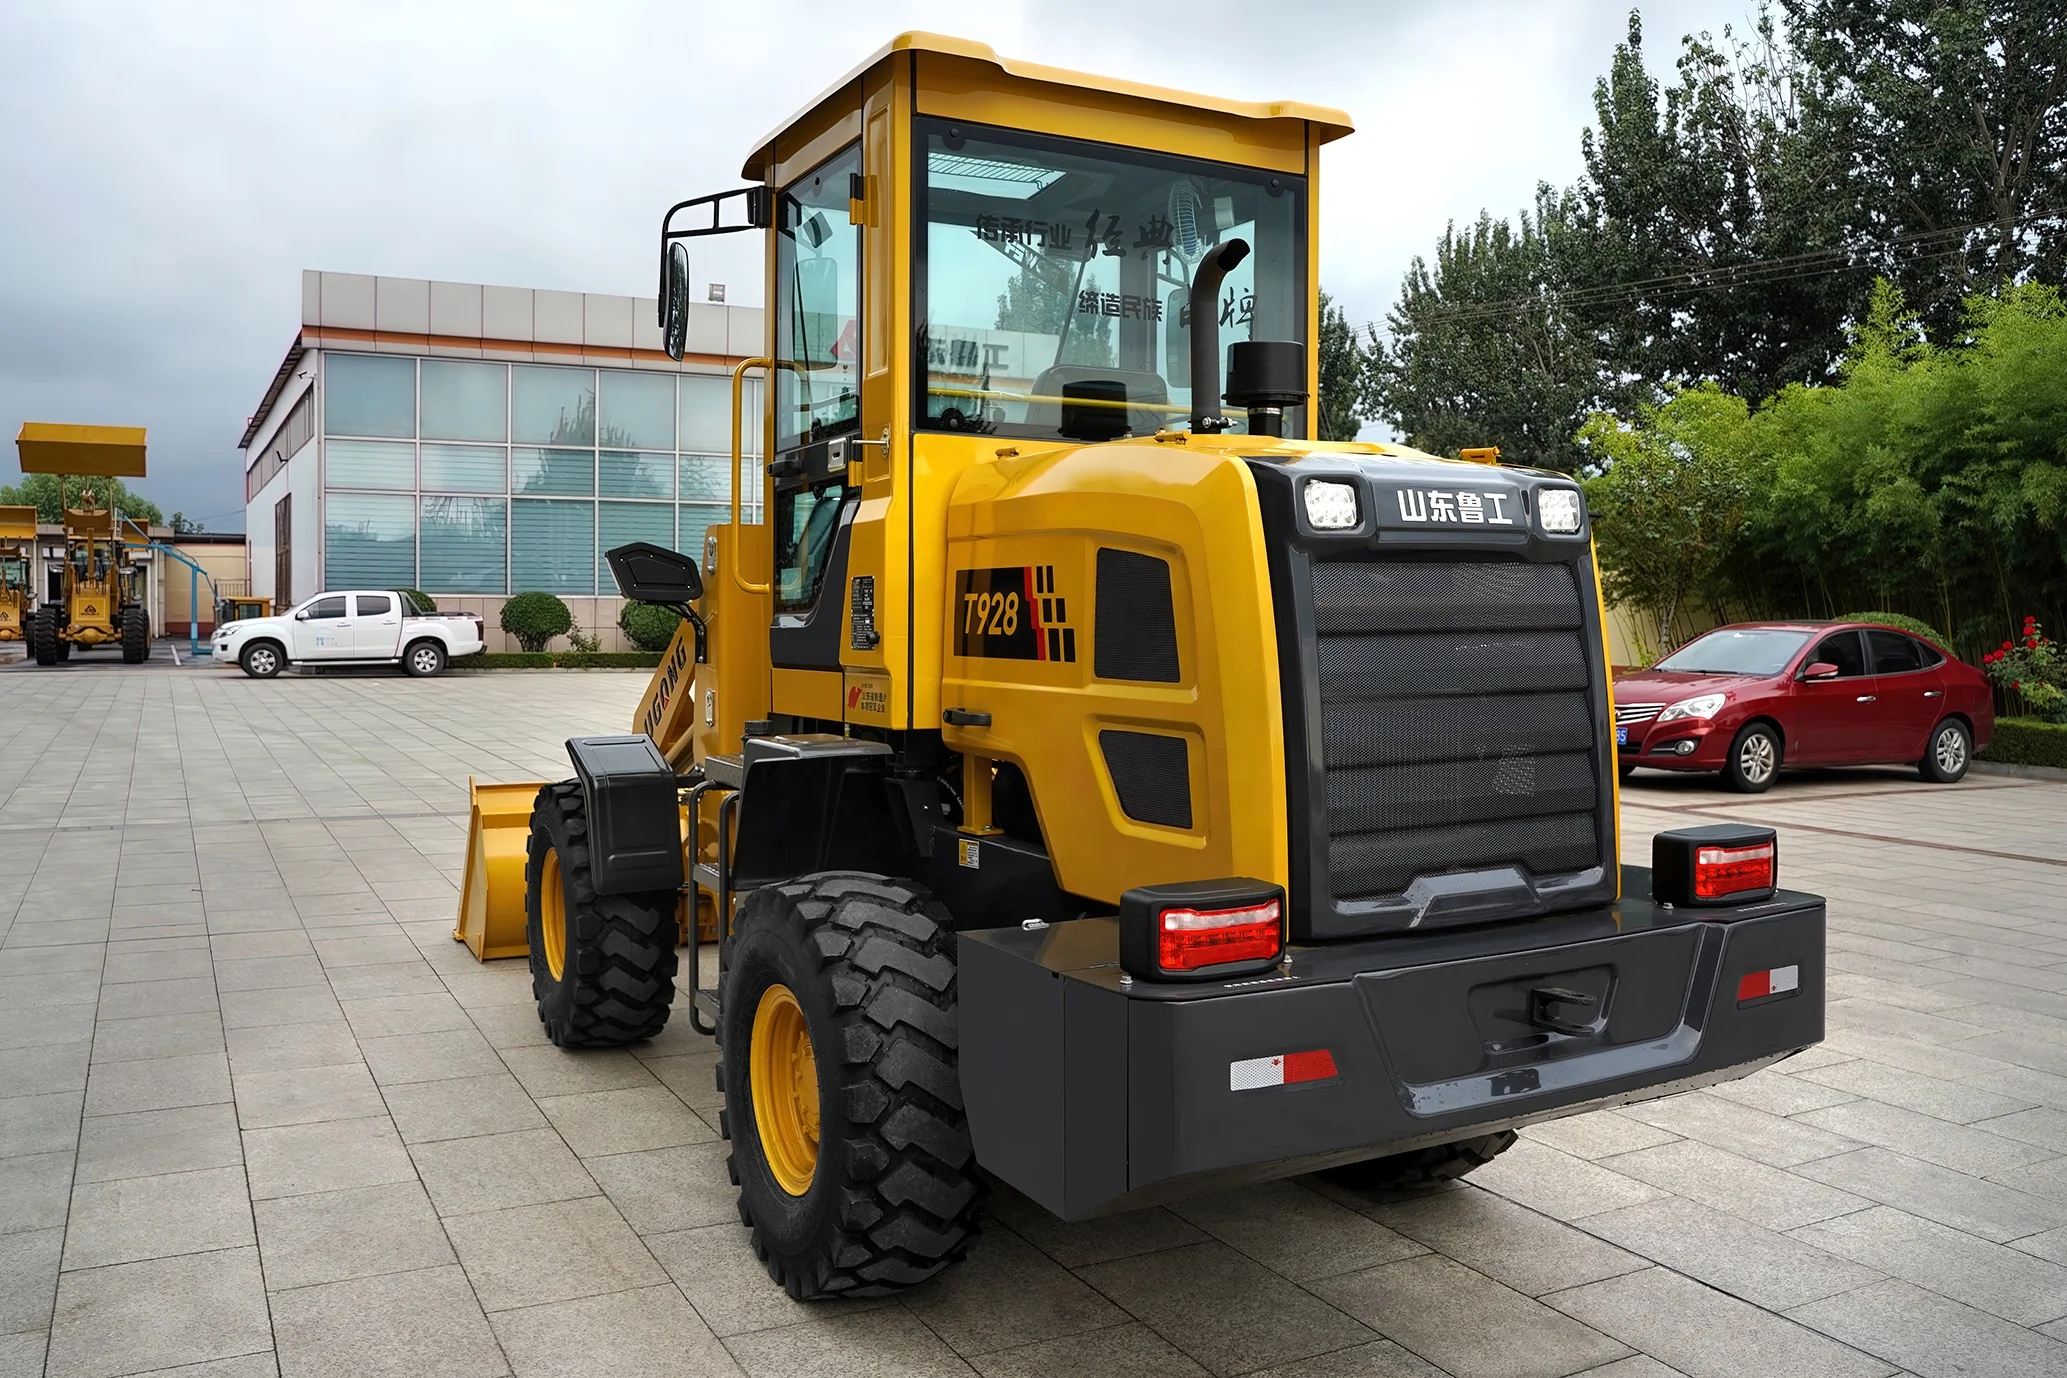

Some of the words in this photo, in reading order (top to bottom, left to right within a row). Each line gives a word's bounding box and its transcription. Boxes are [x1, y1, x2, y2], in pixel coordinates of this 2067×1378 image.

[1397, 488, 1513, 525] 山东鲁工
[964, 591, 1019, 636] T928
